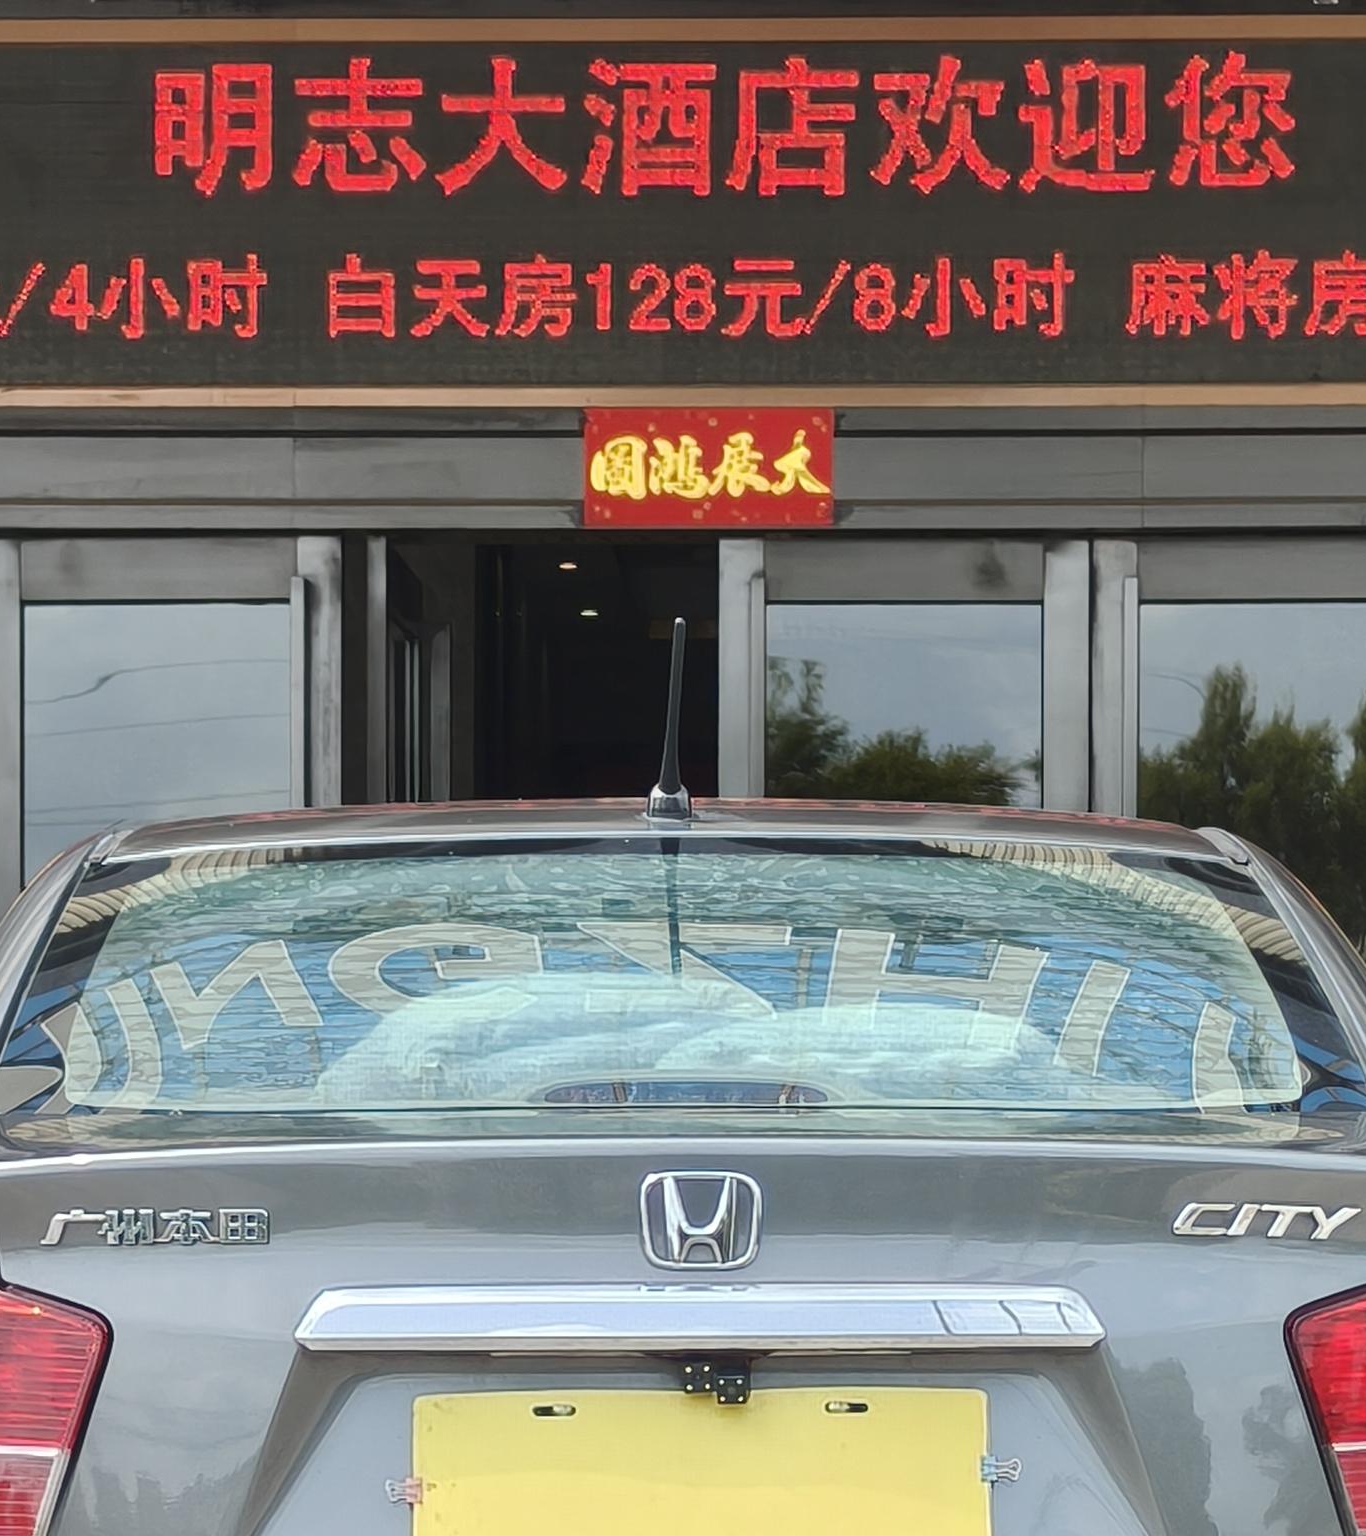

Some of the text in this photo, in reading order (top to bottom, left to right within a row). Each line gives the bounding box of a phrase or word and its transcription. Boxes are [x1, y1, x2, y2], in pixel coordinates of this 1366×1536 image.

[153, 52, 1296, 197] 明志大酒店欢迎您
[327, 253, 1076, 338] 白天房128元/8小时
[39, 1208, 270, 1245] 广州本田
[1172, 1202, 1362, 1240] CITY
